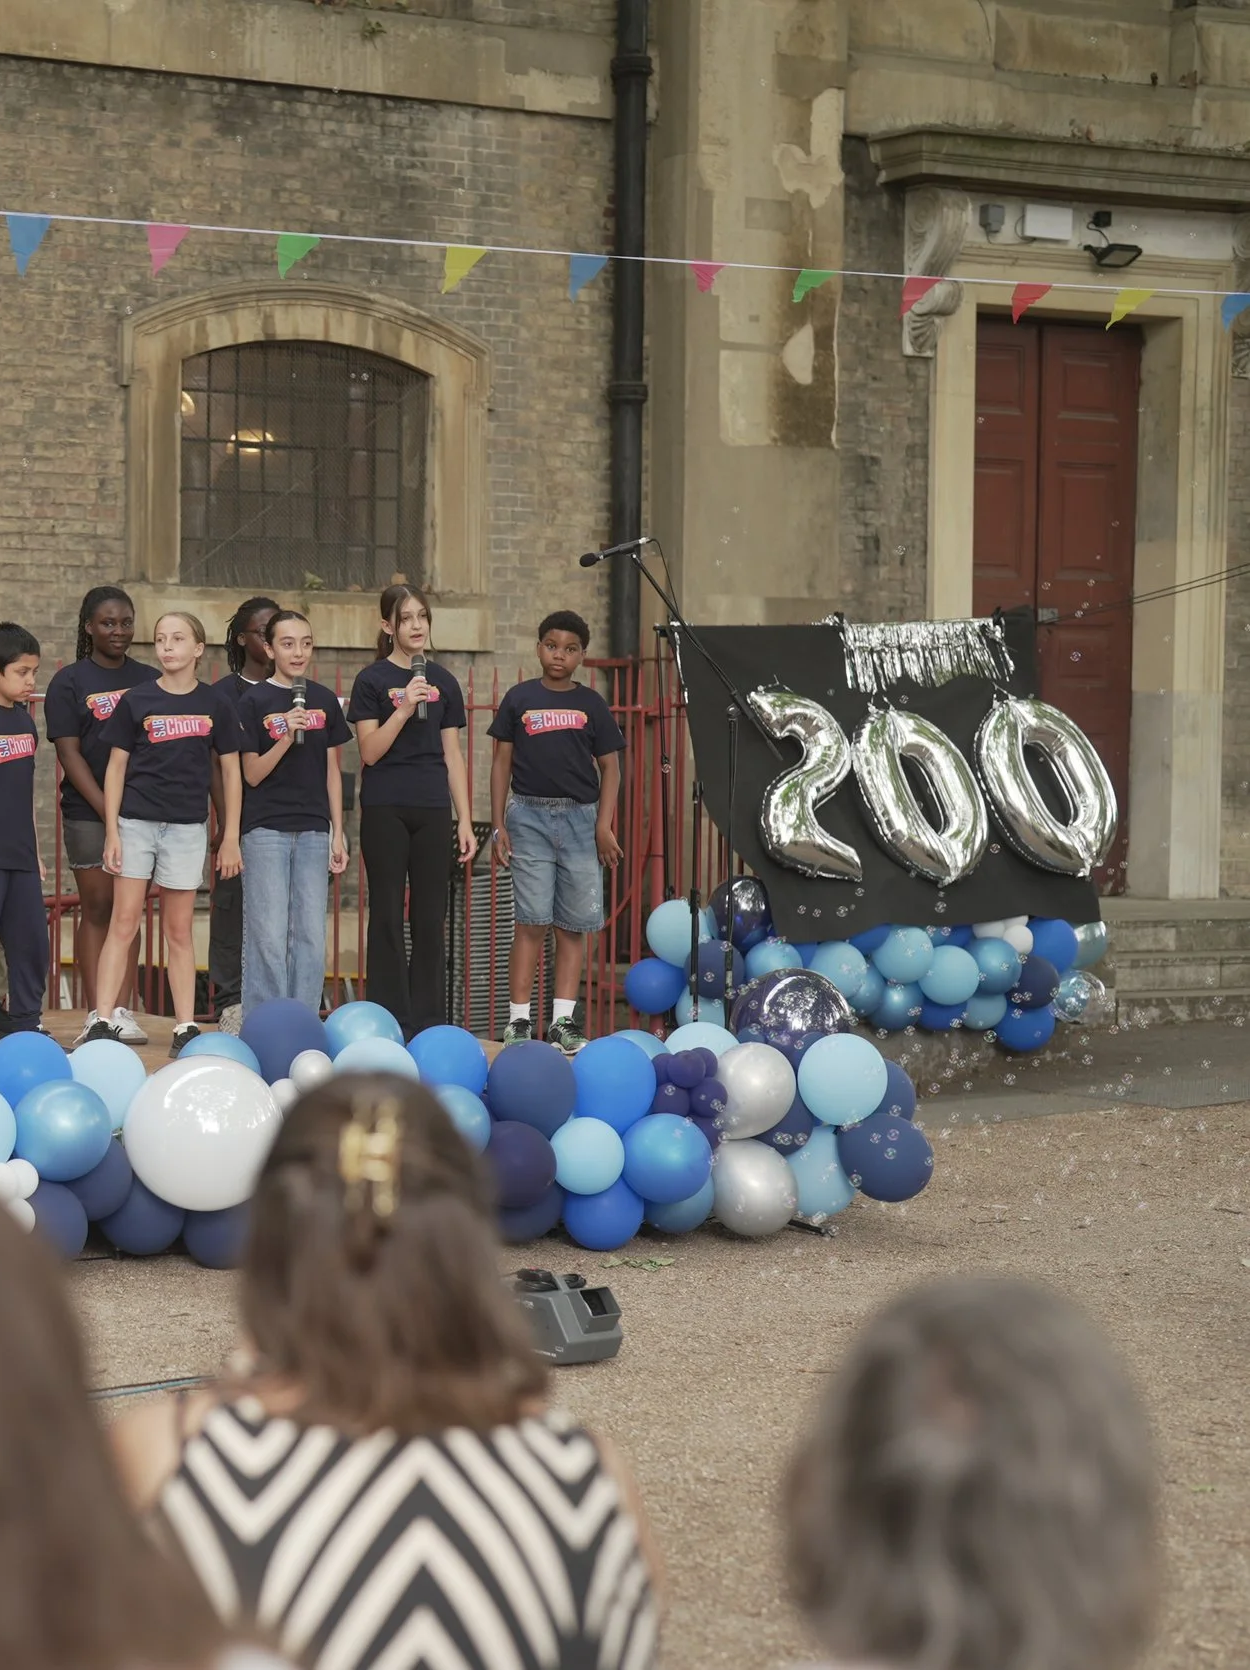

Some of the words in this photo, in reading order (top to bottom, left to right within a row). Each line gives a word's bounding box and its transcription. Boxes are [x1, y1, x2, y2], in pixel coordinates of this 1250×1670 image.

[95, 695, 113, 715] SJB
[152, 719, 167, 738] SJB
[166, 716, 202, 736] Choir
[271, 715, 288, 735] SJB
[530, 712, 543, 730] SJB
[543, 710, 578, 727] Choir
[7, 735, 33, 755] Choir
[747, 690, 1118, 888] 200
